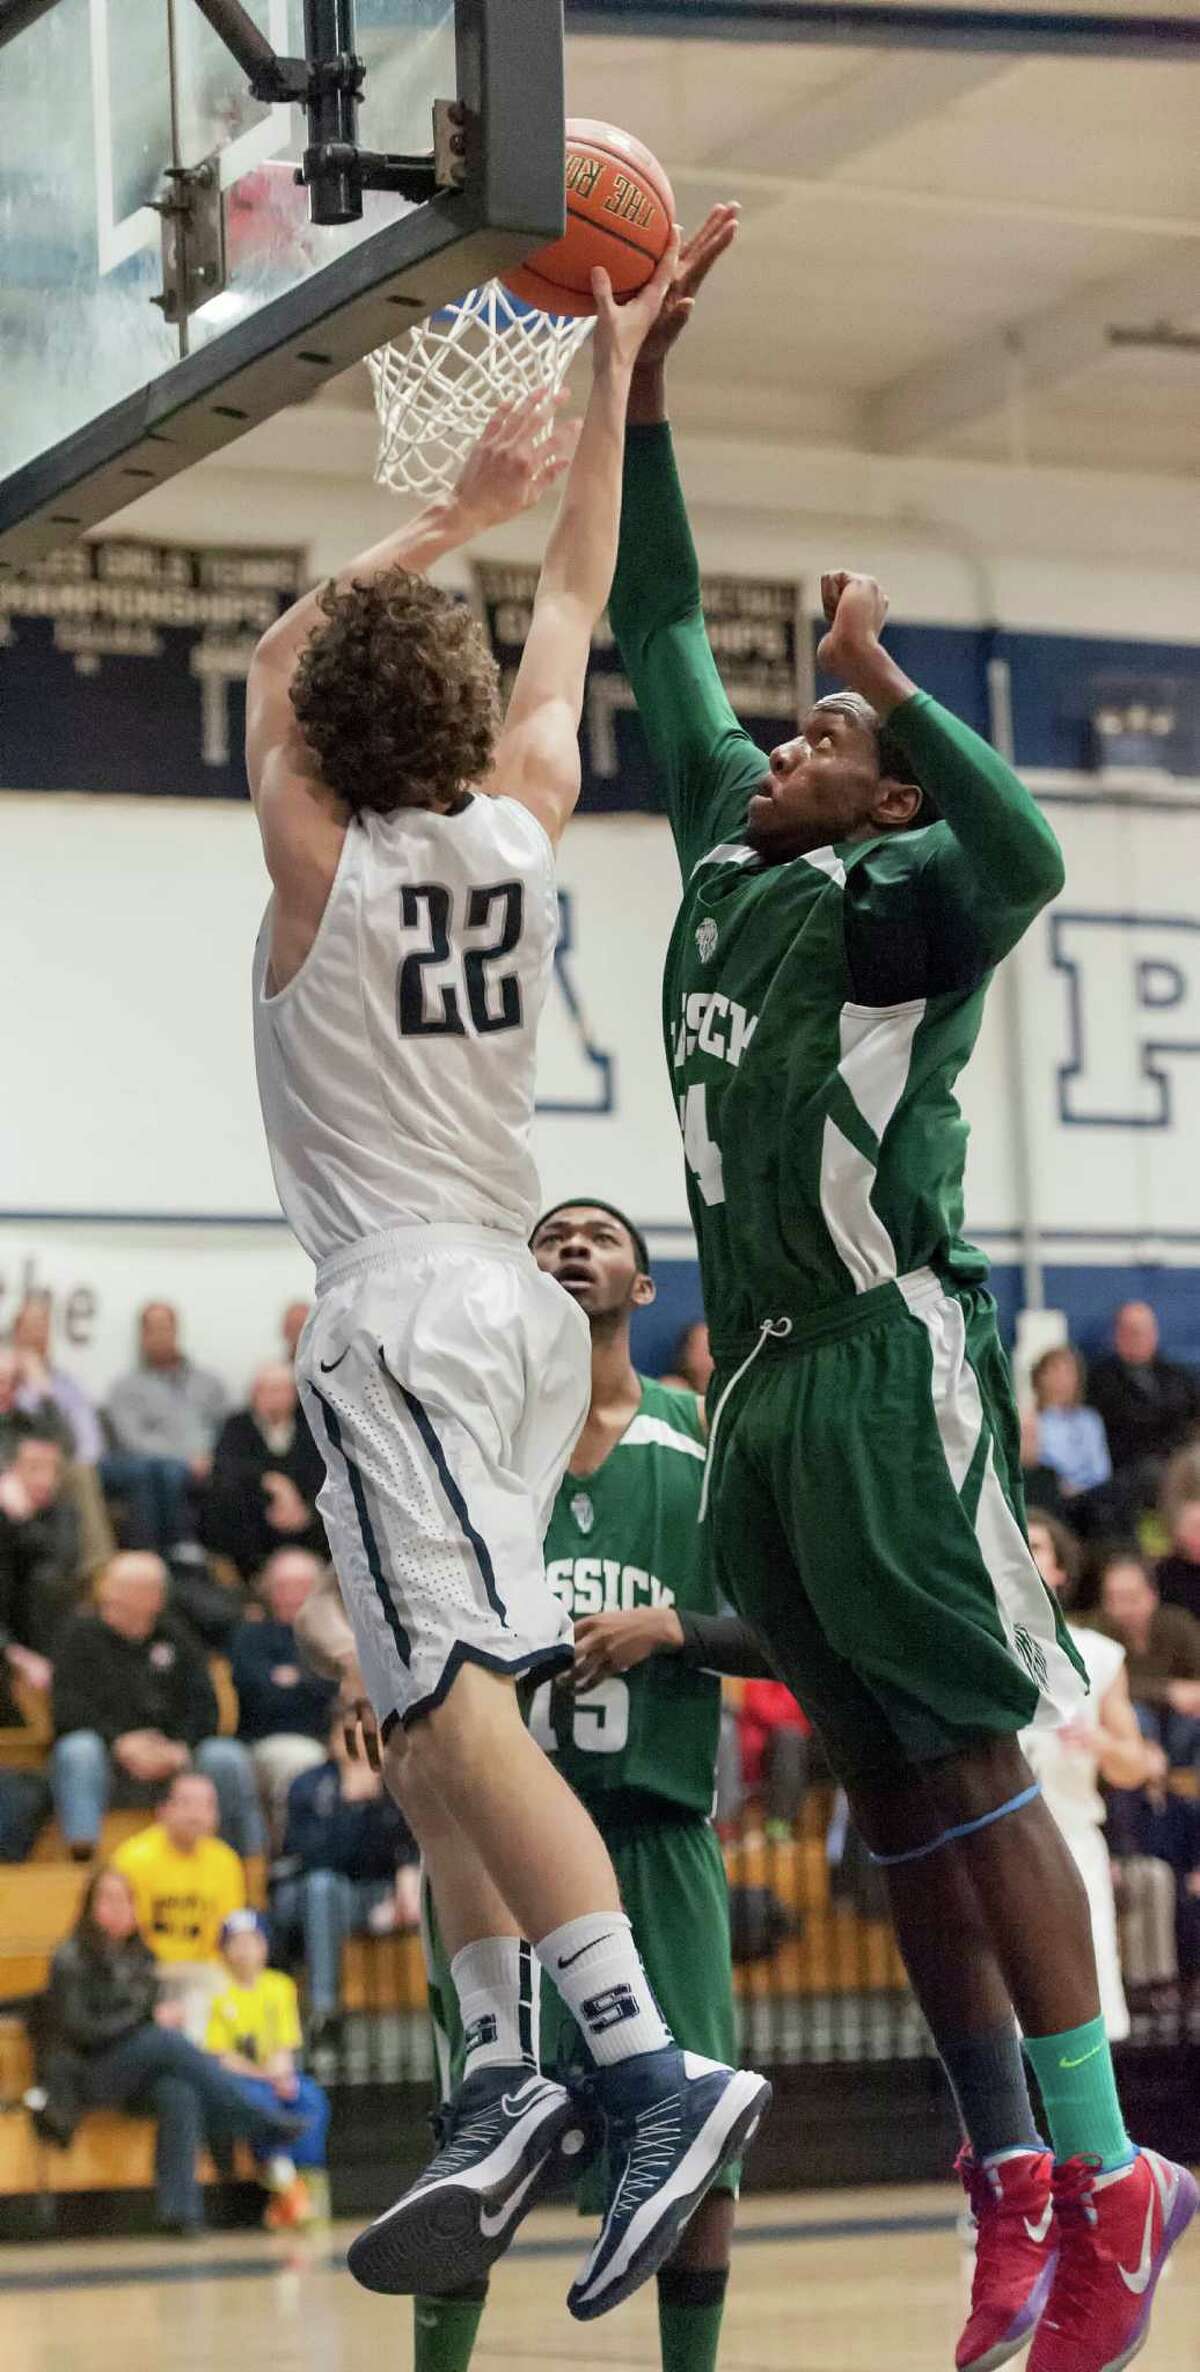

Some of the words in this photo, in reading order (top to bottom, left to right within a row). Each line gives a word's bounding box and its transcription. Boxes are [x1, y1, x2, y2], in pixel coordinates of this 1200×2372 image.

[603, 173, 656, 230] THE
[397, 877, 525, 1039] 22
[582, 1982, 641, 2036] S
